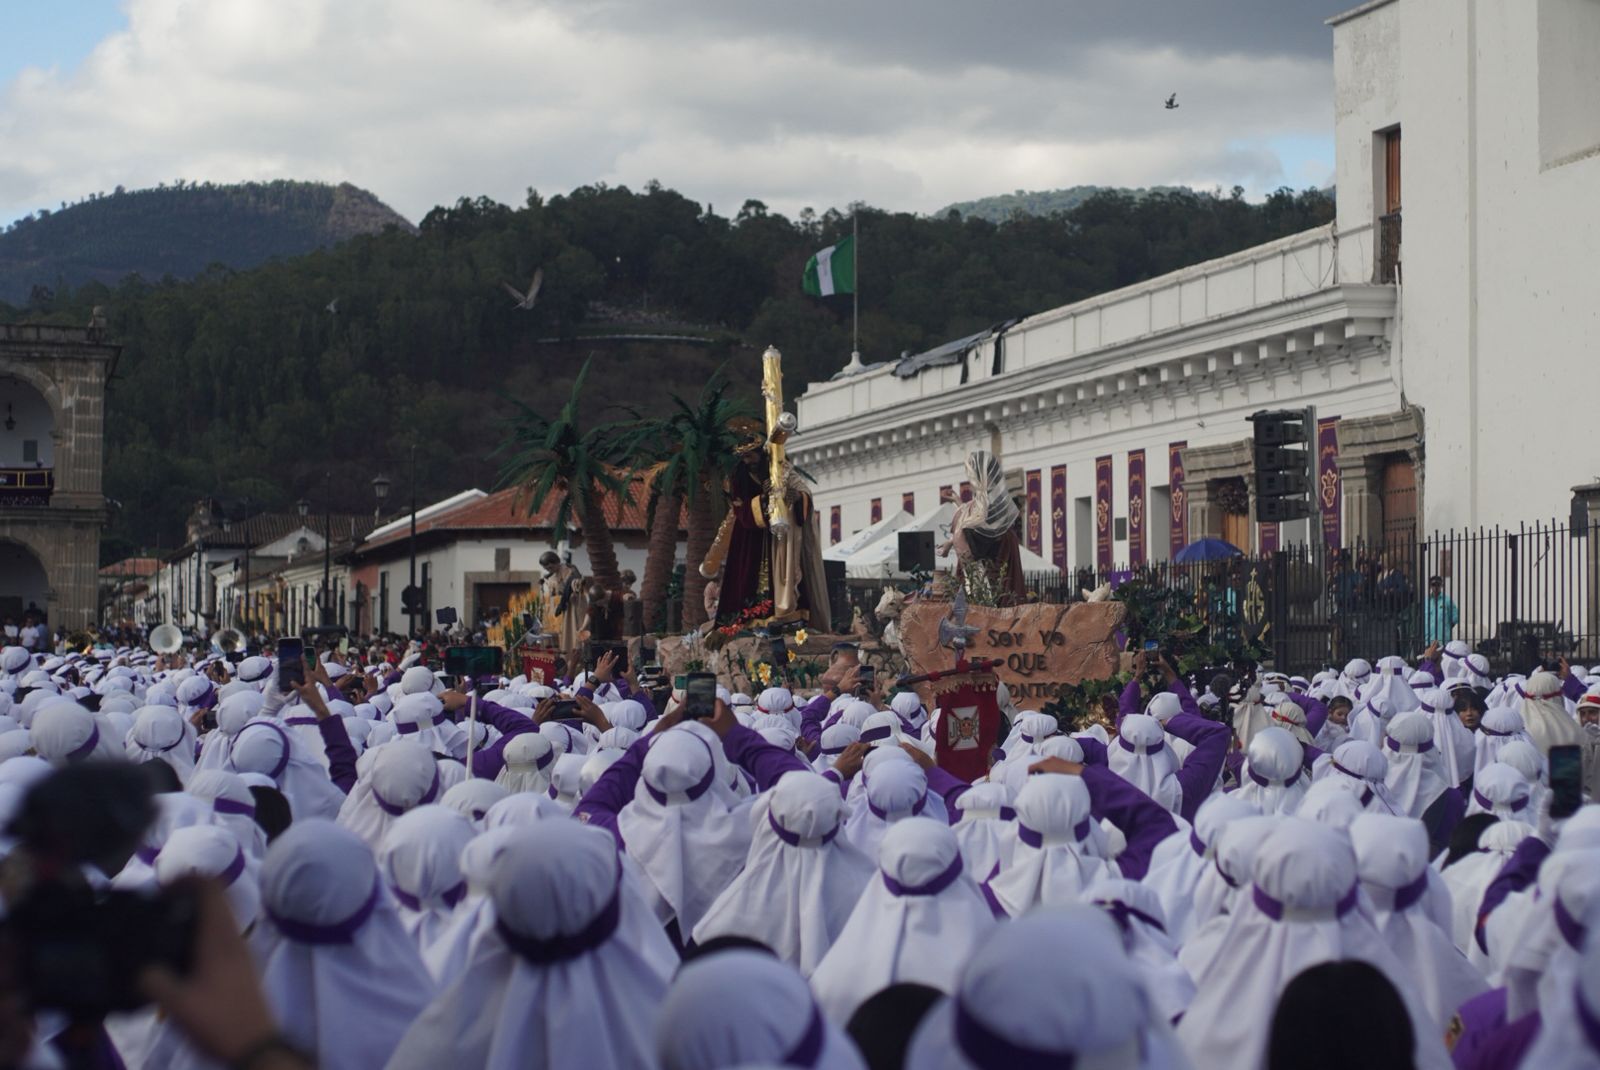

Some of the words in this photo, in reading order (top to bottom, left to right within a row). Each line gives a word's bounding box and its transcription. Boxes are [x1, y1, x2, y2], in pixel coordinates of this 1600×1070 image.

[987, 629, 1023, 647] SOY
[1008, 652, 1048, 677] QUE
[1003, 682, 1074, 698] ONTIGO
